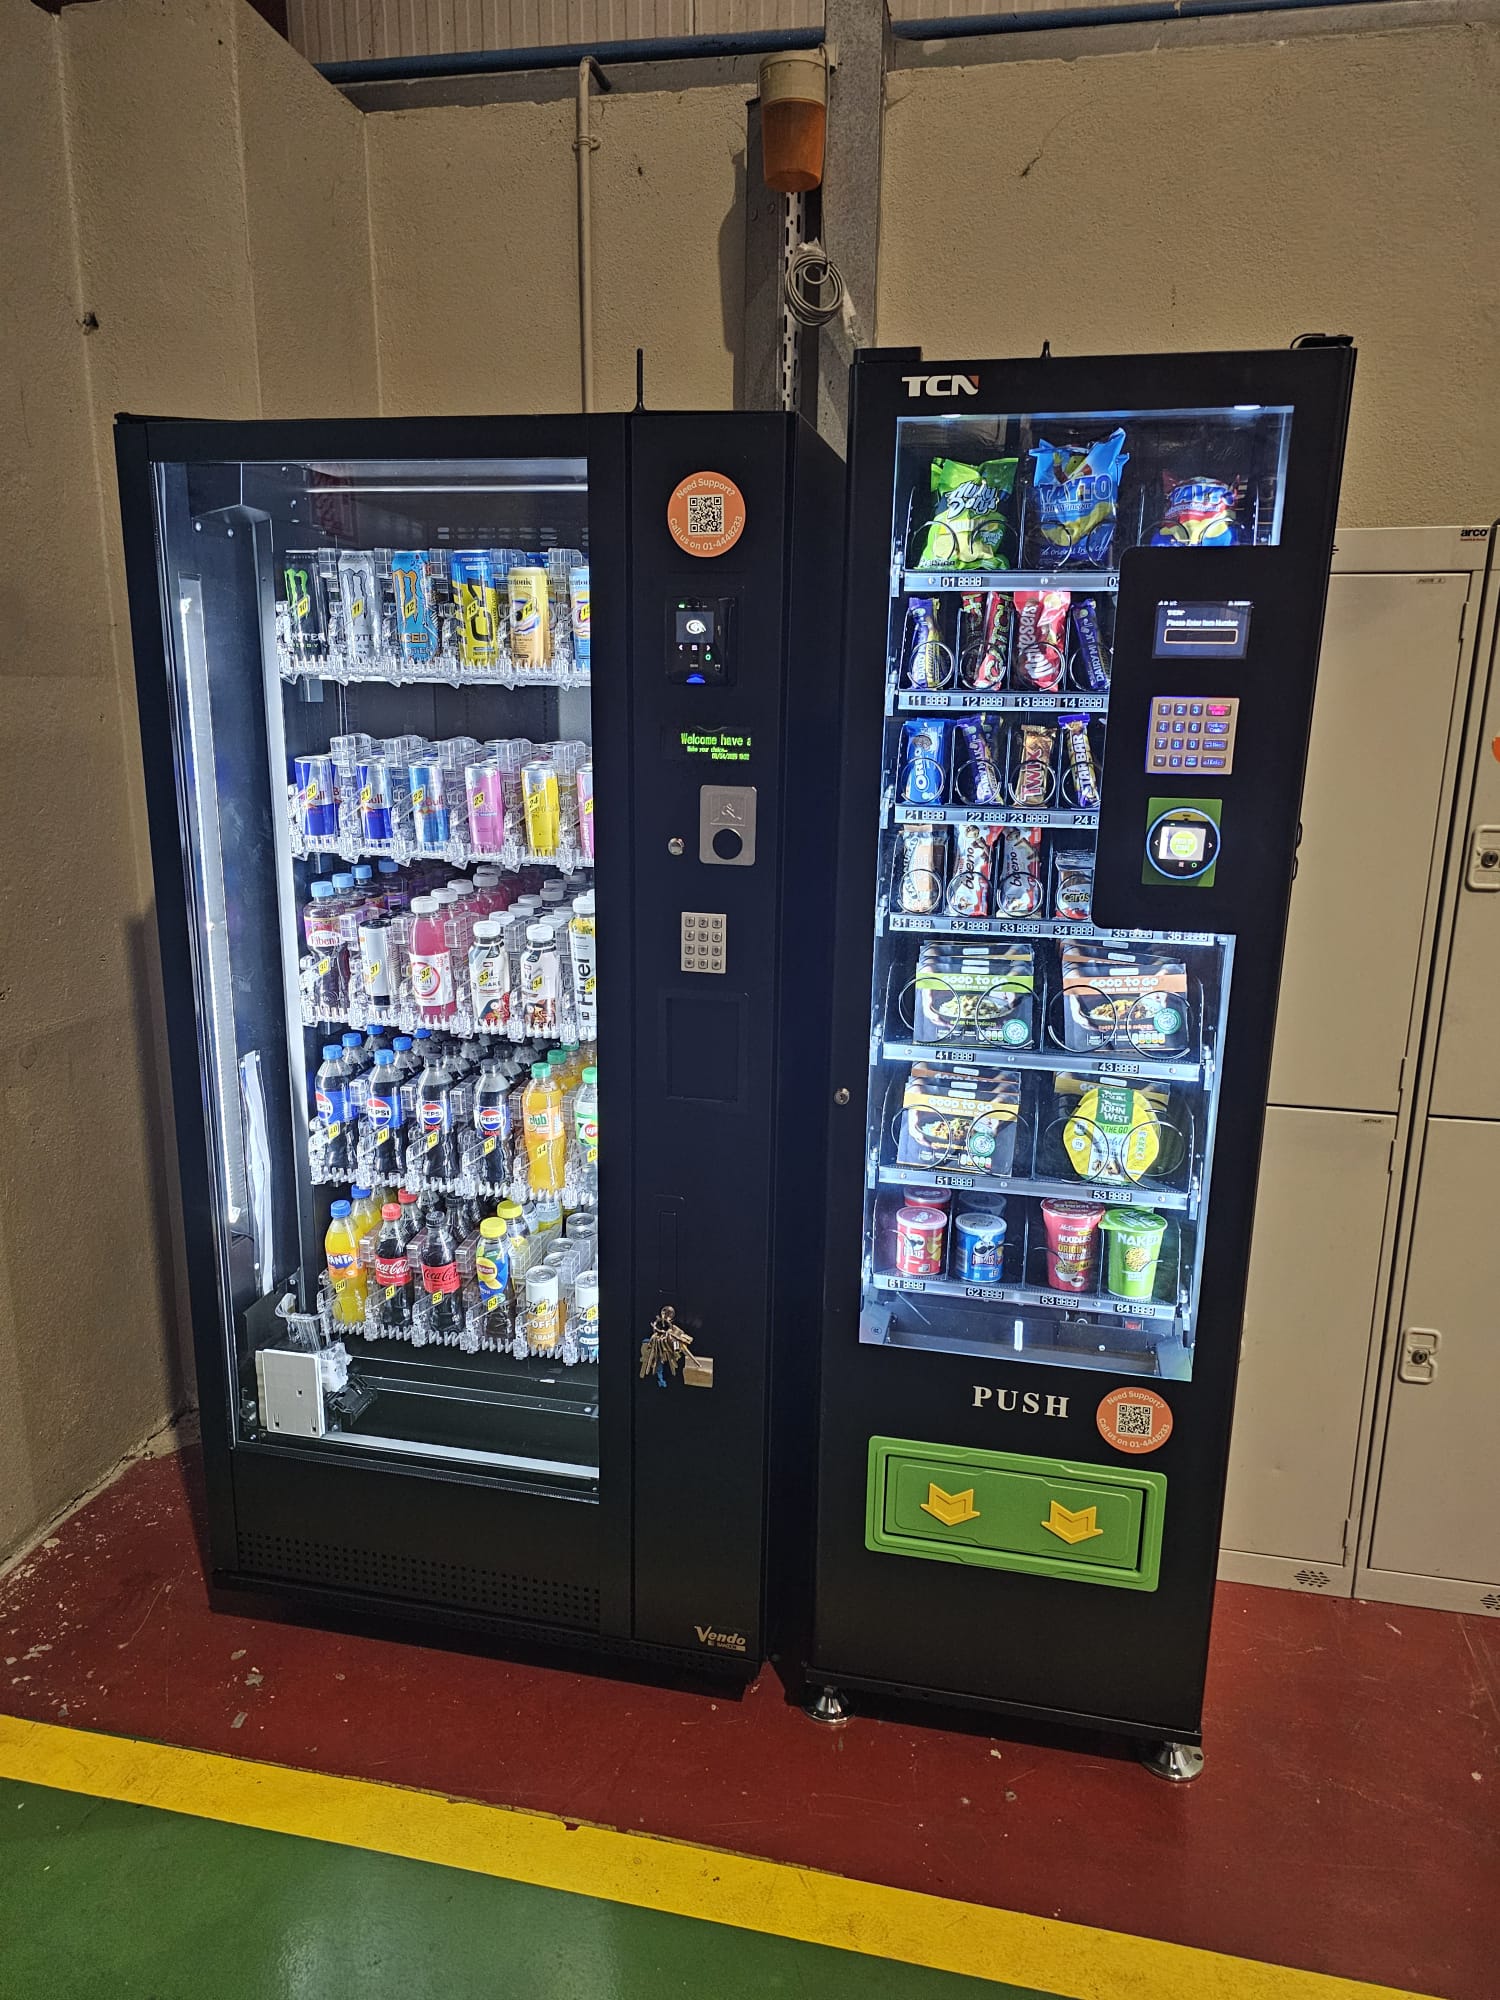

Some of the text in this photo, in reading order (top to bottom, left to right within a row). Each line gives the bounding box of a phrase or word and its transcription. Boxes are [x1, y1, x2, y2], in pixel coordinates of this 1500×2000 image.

[902, 375, 979, 397] TCN
[676, 478, 736, 499] Need Support?
[670, 518, 681, 536] Call
[680, 534, 690, 544] us
[690, 541, 701, 550] on
[1461, 529, 1488, 537] arco
[942, 577, 955, 587] 01
[407, 602, 415, 614] 12
[525, 603, 533, 615] 14
[1091, 655, 1104, 682] DAIRY
[910, 696, 922, 706] 11
[964, 696, 979, 707] 12
[1017, 696, 1031, 708] 13
[1063, 697, 1077, 708] 14
[1162, 706, 1167, 714] 1
[1177, 706, 1183, 714] 2
[1193, 706, 1199, 714] 3
[1160, 723, 1197, 731] 4 5 6
[681, 733, 718, 745] Welcome
[721, 733, 744, 746] have
[1159, 740, 1164, 748] 7
[1021, 749, 1043, 801] TWIX
[474, 793, 484, 806] 23
[529, 796, 538, 808] 24
[906, 810, 920, 820] 21
[967, 812, 982, 822] 22
[1010, 813, 1024, 823] 23
[1075, 815, 1088, 825] 24
[961, 848, 975, 890] bueno
[1010, 851, 1022, 887] bueno
[1062, 892, 1090, 902] Cards
[893, 918, 906, 928] 31
[951, 920, 966, 930] 32
[1001, 923, 1015, 933] 33
[1054, 925, 1068, 935] 34
[1112, 930, 1127, 938] 35
[1167, 932, 1182, 941] 36
[578, 958, 593, 1006] Huel
[936, 1051, 949, 1060] 41
[1100, 1063, 1114, 1072] 43
[1101, 1104, 1127, 1114] JOHN
[1103, 1112, 1129, 1123] WEST
[1118, 1126, 1129, 1134] GO
[429, 1133, 437, 1144] 42
[486, 1139, 494, 1149] 43
[538, 1145, 546, 1155] 44
[937, 1176, 949, 1185] 51
[1094, 1190, 1107, 1199] 53
[336, 1281, 345, 1291] 50
[889, 1280, 900, 1288] 61
[386, 1286, 393, 1296] 51
[967, 1288, 980, 1297] 62
[433, 1293, 441, 1302] 52
[1041, 1296, 1054, 1305] 63
[488, 1298, 497, 1308] 53
[538, 1304, 547, 1313] 54
[1117, 1304, 1130, 1313] 64
[971, 1385, 1070, 1419] PUSH
[1107, 1390, 1165, 1409] Need Support?
[1099, 1418, 1110, 1432] Call
[1107, 1432, 1117, 1441] us
[1117, 1438, 1128, 1447] on
[693, 1625, 747, 1646] Vendo
